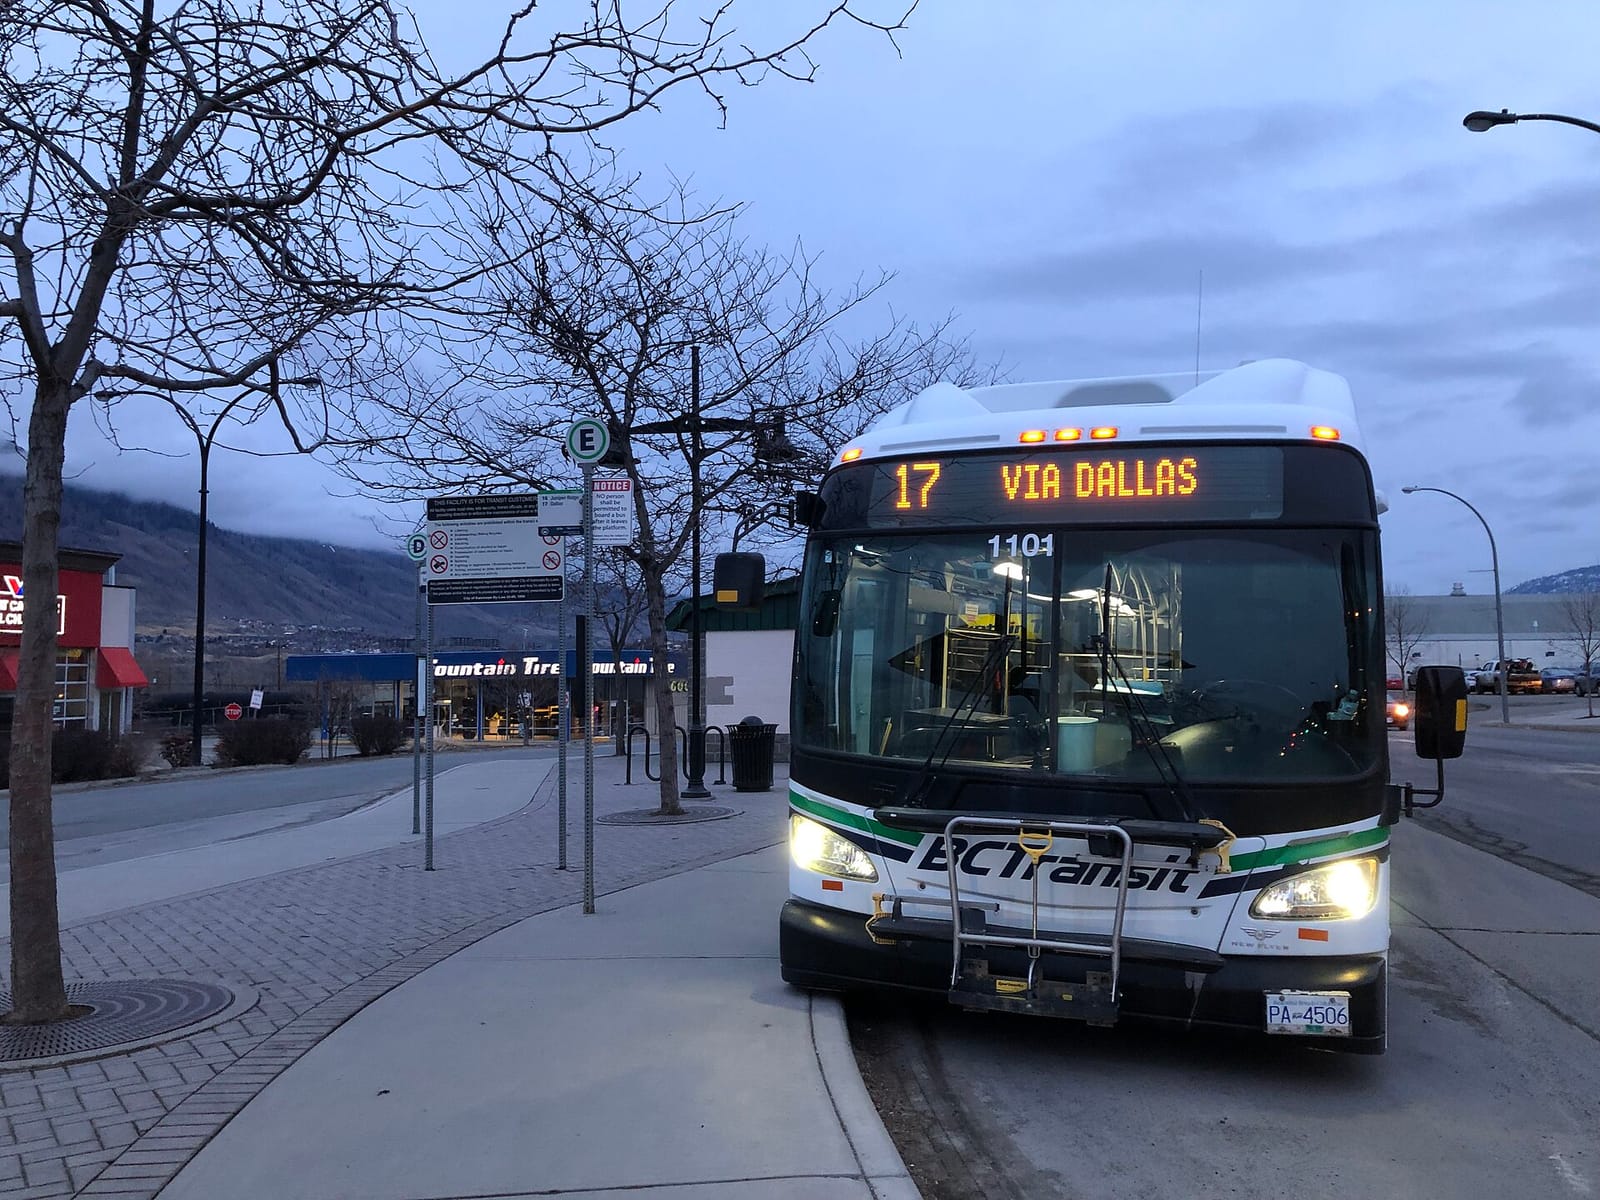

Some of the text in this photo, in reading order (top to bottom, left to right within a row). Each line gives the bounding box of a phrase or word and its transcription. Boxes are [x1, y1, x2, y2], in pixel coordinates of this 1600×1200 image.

[580, 429, 595, 452] E
[593, 481, 629, 491] NOTICE
[895, 457, 1198, 509] 17 VIA DALLAS
[413, 539, 425, 554] D
[988, 533, 1054, 558] 1101
[433, 656, 561, 677] ountain Tire
